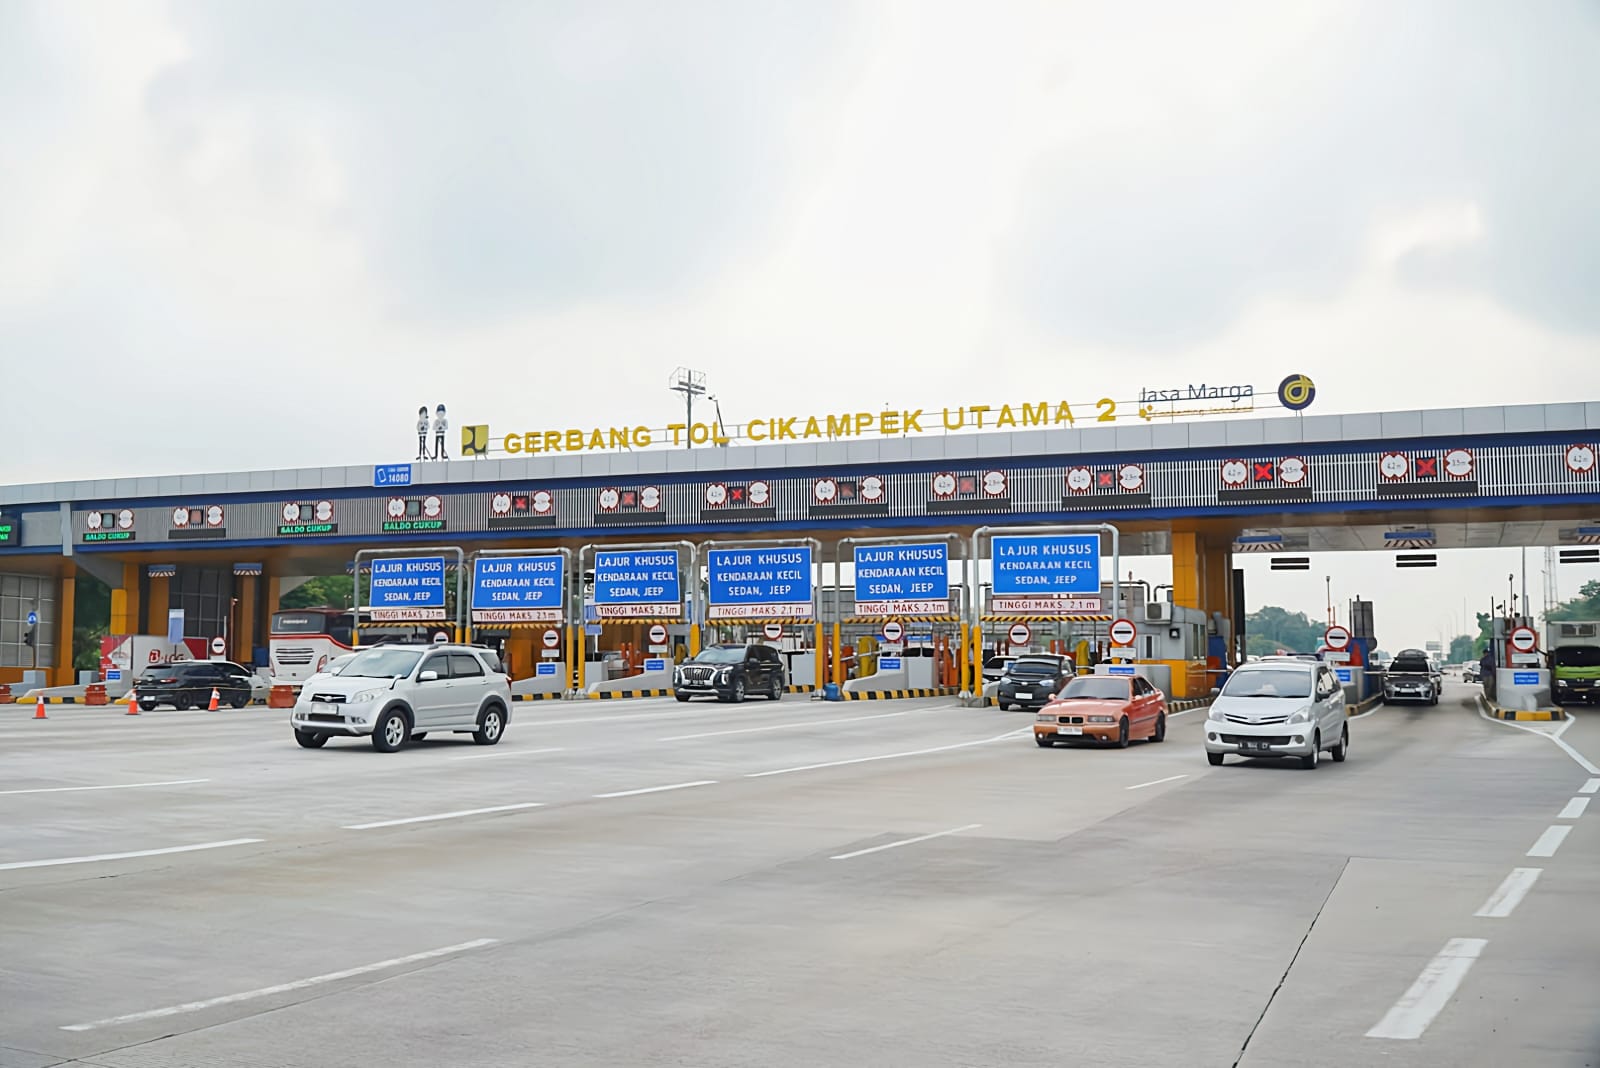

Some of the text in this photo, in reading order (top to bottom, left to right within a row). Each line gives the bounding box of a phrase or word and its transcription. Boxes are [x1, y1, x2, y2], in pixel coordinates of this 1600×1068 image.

[1189, 384, 1253, 402] Marga
[503, 398, 1117, 453] GERBANG TOL CIKAMPEK UTAMA 2
[413, 522, 442, 530] CUKUP
[859, 549, 943, 562] LAJUR KHUSUS
[1000, 544, 1092, 556] LAJUR KHUSUS
[599, 555, 674, 567] LAJUR KHUSUS
[717, 553, 802, 566] LAJUR KHUSUS
[376, 562, 441, 573] LAJUR KHUSUS
[482, 562, 556, 573] LAJUR KHUSUS
[1000, 561, 1092, 570] KENDARAAN KECIL
[598, 572, 675, 582] KENDARAAN KECIL
[718, 570, 802, 582] KENDARAAN KECIL
[858, 566, 944, 578] KENDARAAN KECIL
[374, 578, 442, 587] KENDARAAN KECIL
[481, 578, 530, 588] KENDARAAN
[1054, 576, 1077, 584] JEEP
[644, 587, 664, 596] JEEP
[728, 585, 791, 596] SEDAN, JEEP
[869, 583, 934, 594] SEDAN, JEEP
[413, 592, 431, 600] JEEP
[524, 592, 543, 600] JEEP
[601, 607, 627, 615] TINGGI
